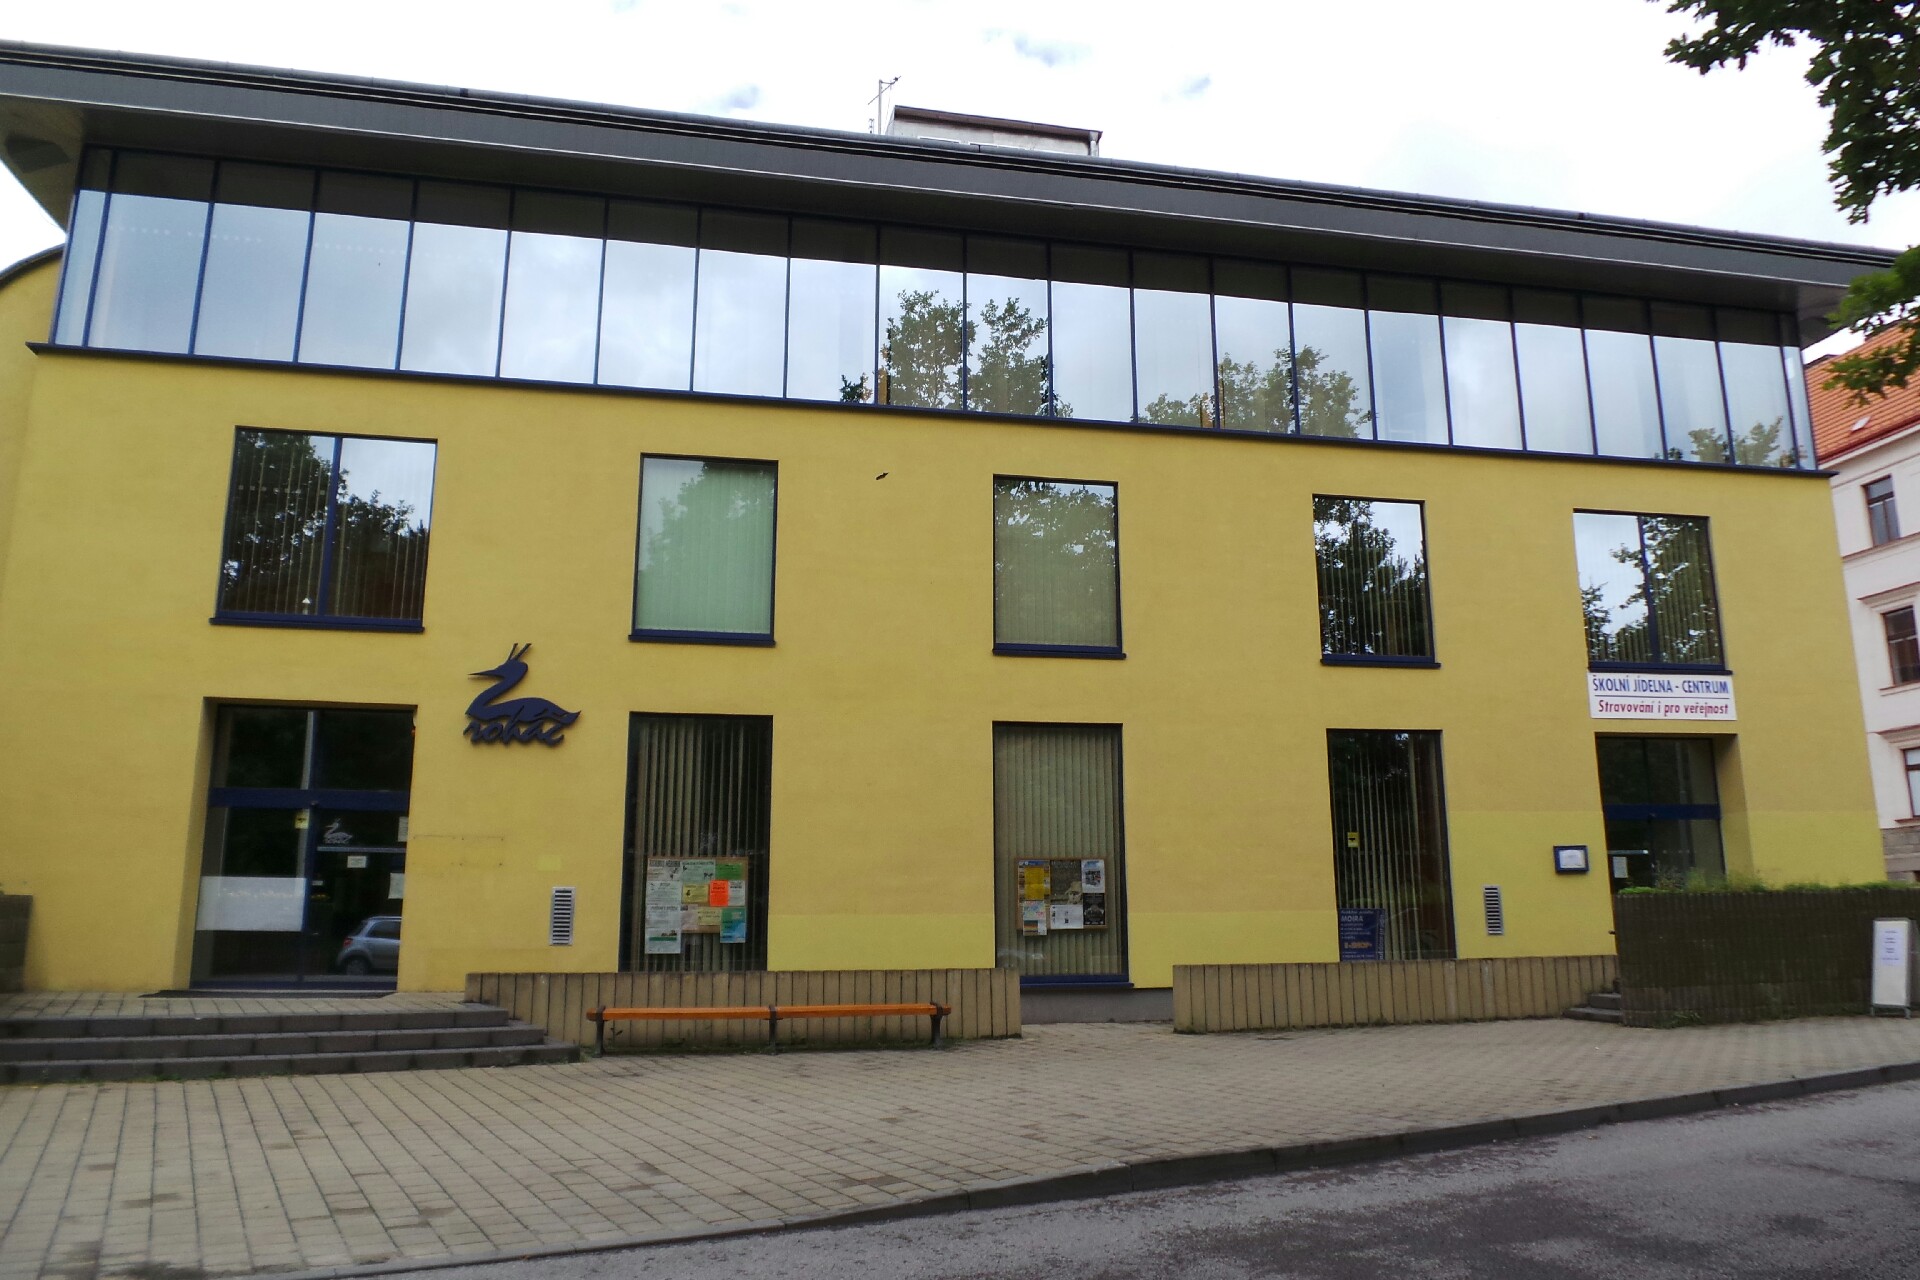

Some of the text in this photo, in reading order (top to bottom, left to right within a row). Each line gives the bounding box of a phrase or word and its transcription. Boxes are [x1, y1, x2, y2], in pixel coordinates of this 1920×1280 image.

[1593, 675, 1630, 692] ŠKOLNÍ
[1633, 675, 1673, 692] JÍDELNA
[1682, 679, 1729, 694] CENTRUM
[1598, 699, 1654, 713] Stravování
[1664, 704, 1680, 717] pro
[1684, 702, 1729, 717] veřejnost
